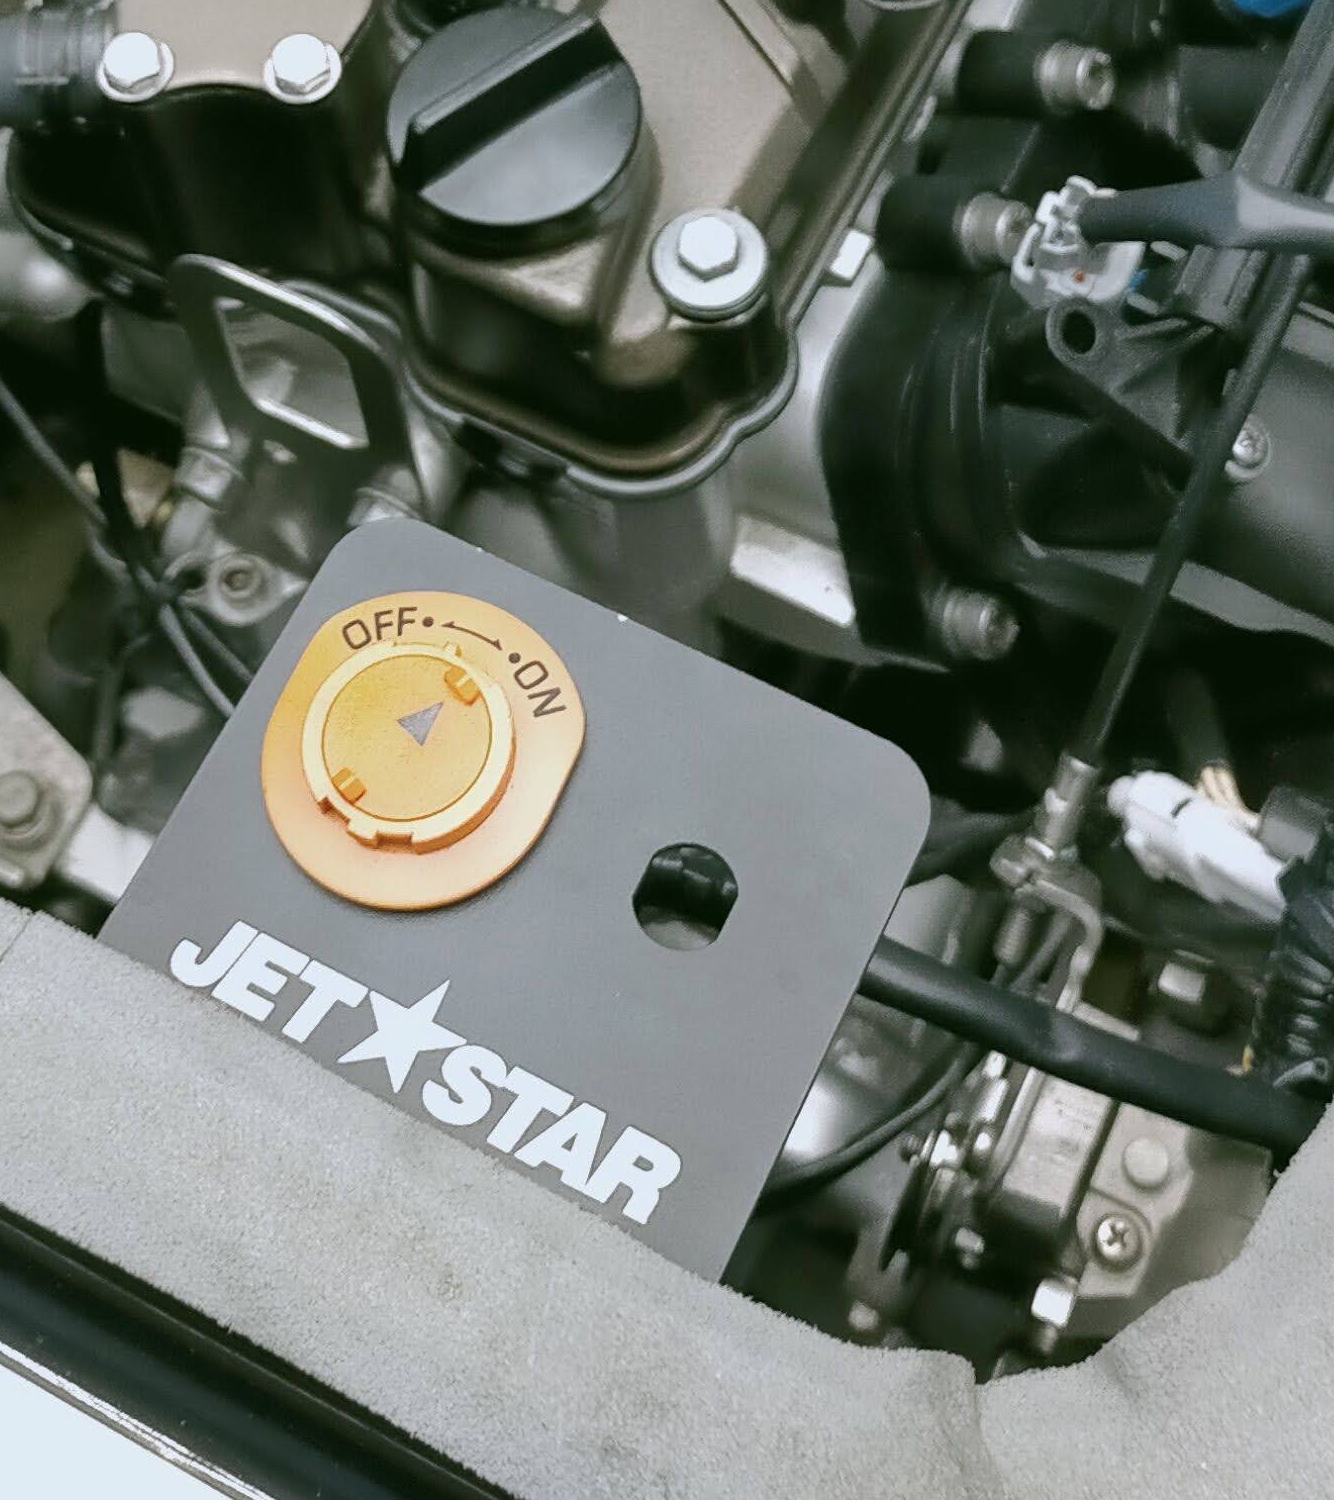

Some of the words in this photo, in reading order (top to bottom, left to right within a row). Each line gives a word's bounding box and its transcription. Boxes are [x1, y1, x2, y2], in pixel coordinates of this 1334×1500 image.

[341, 606, 418, 650] OFF
[513, 659, 567, 718] ON
[169, 920, 369, 1044] JET
[421, 1044, 683, 1225] STAR
